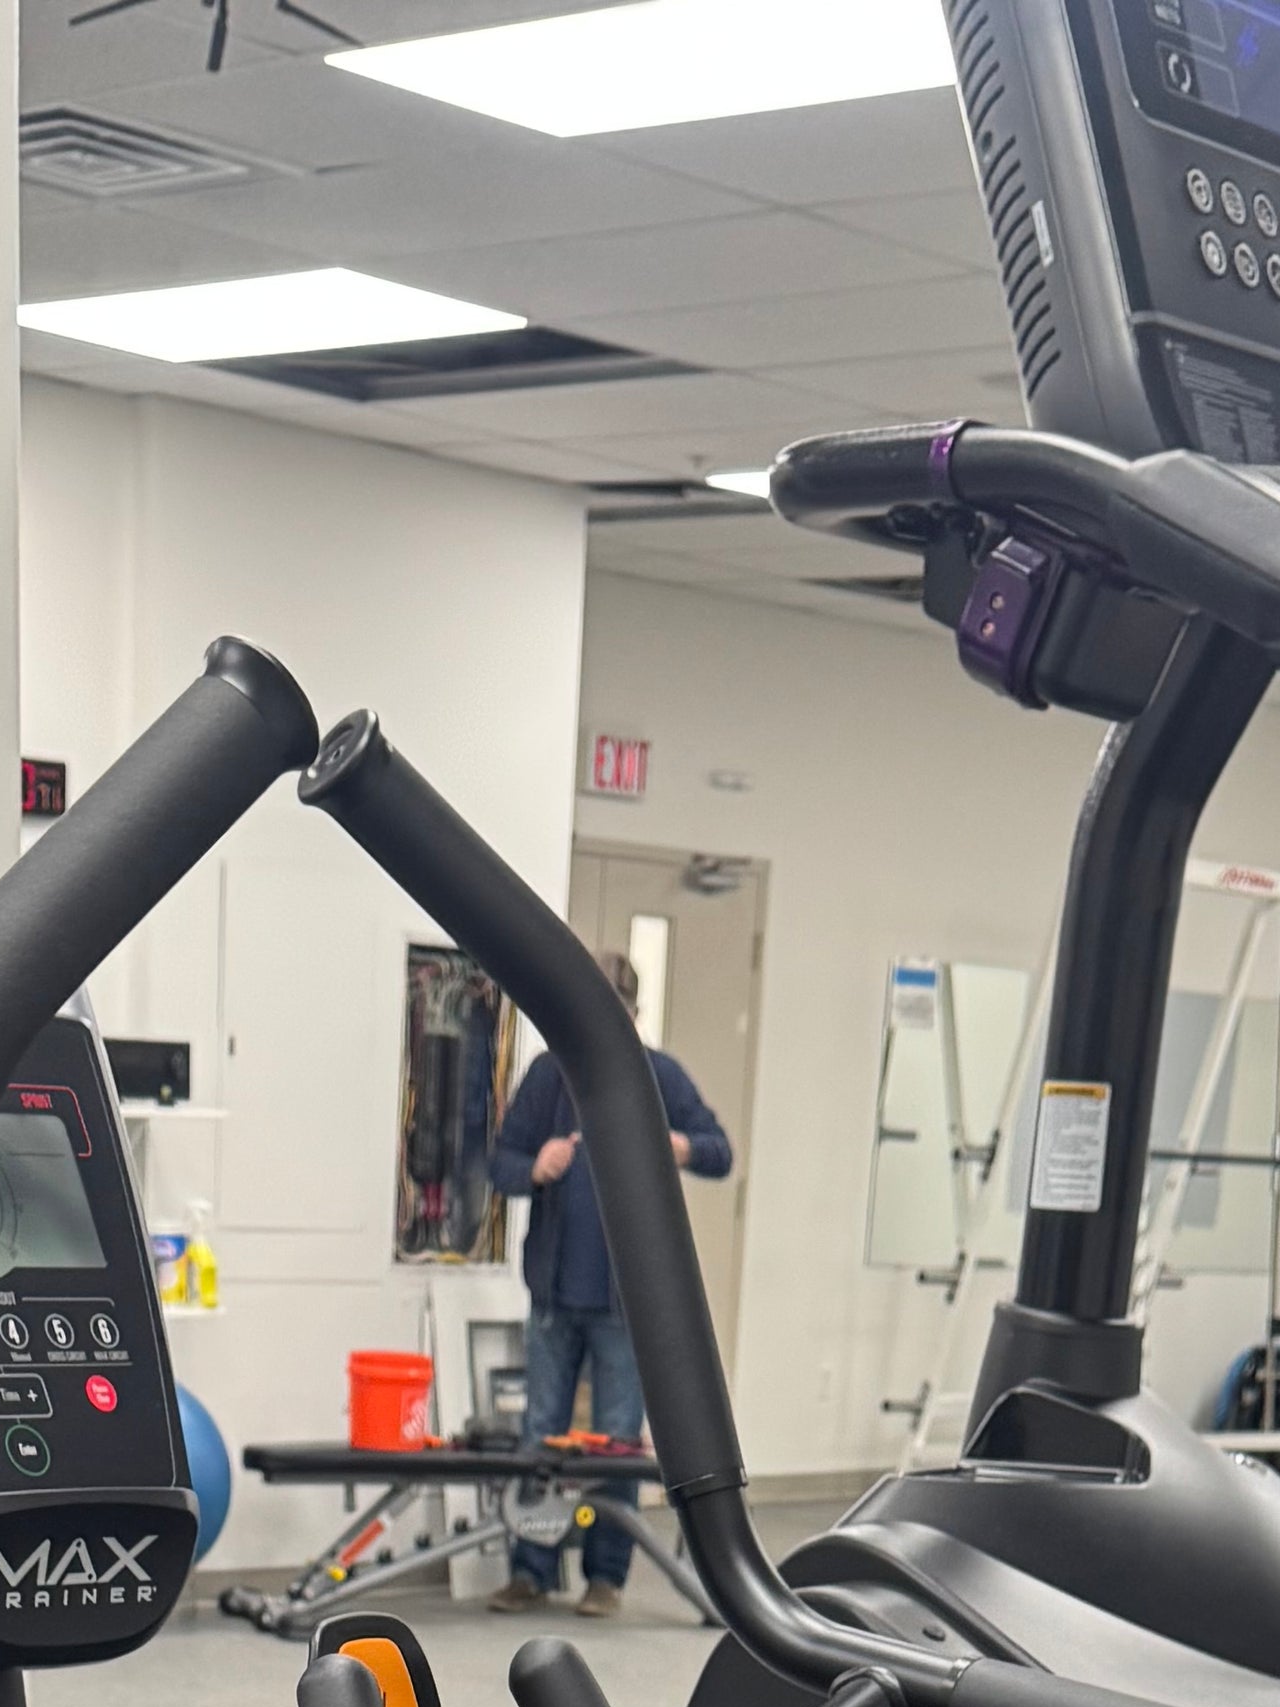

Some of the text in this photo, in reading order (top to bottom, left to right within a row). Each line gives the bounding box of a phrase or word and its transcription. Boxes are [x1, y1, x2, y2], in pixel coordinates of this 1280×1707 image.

[594, 735, 648, 792] EXIT
[20, 1092, 53, 1110] SPRINT
[7, 1318, 21, 1345] 4
[51, 1318, 67, 1345] 5
[97, 1317, 113, 1344] 6
